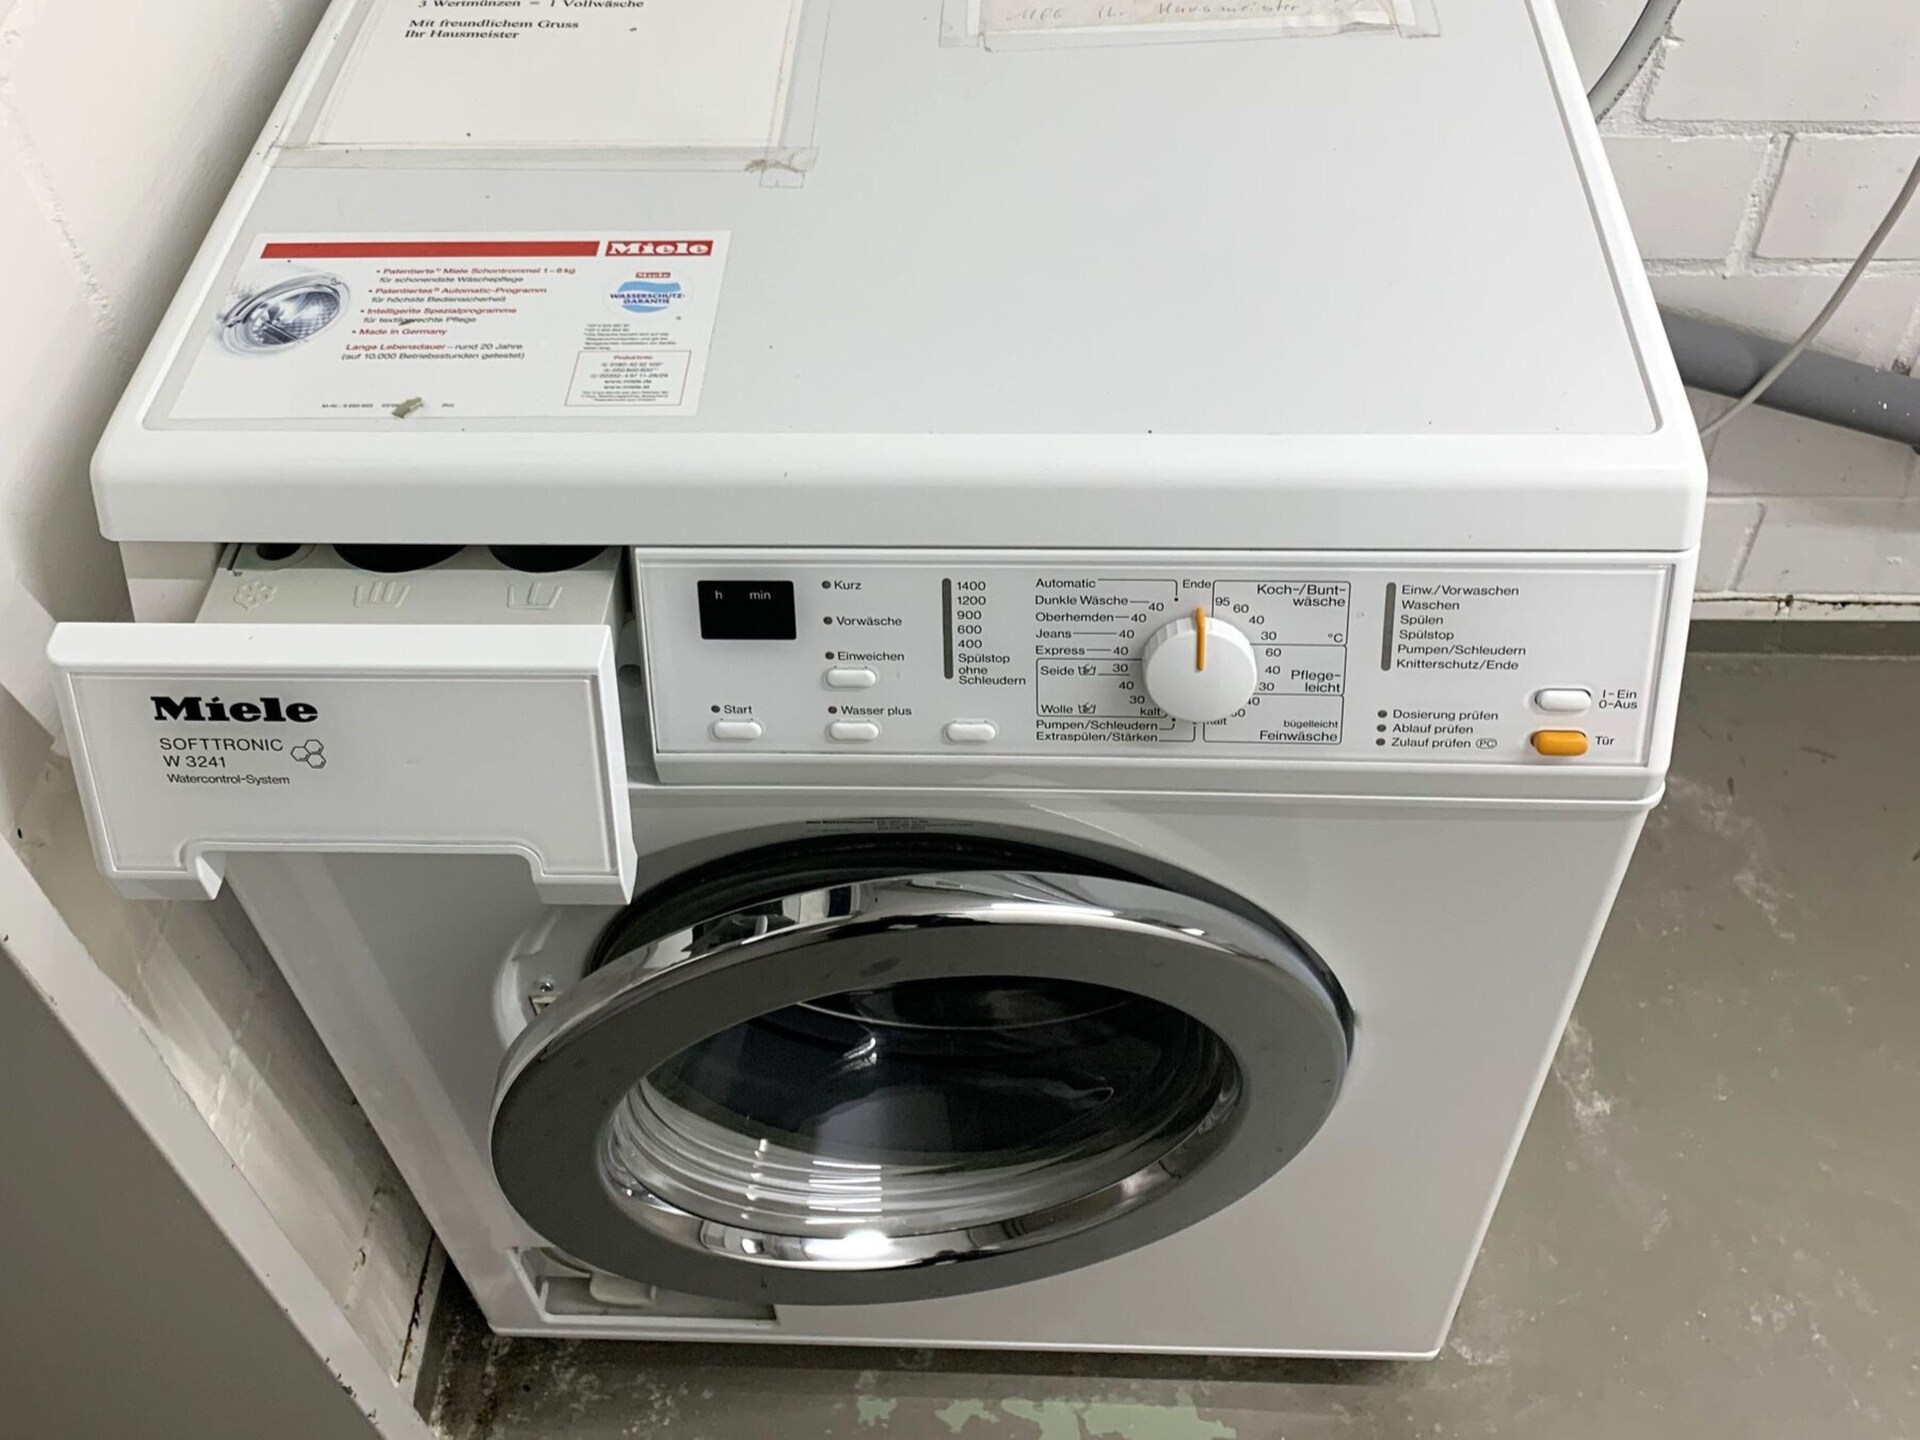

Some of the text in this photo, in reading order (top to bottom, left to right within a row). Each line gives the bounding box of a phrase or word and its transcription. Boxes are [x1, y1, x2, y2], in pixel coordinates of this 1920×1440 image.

[440, 19, 532, 28] freundlichem
[538, 20, 578, 28] Gruss
[405, 30, 519, 38] Ihr Hausmeister
[607, 242, 710, 256] Miele
[442, 267, 469, 275] Miele
[367, 307, 517, 317] Intelligente Spezialprogramme
[446, 316, 476, 324] Pflege
[402, 328, 447, 336] Germany
[481, 352, 525, 360] getestet)
[834, 580, 861, 590] Kurz
[957, 581, 986, 591] 1400
[1036, 578, 1095, 588] Automatic
[1183, 579, 1211, 588] Ende
[715, 590, 771, 599] h min
[1257, 584, 1345, 595] Koch-/Bunt-
[1402, 585, 1519, 595] Einw./Vorwaschen
[958, 596, 986, 605] 1200
[1035, 595, 1128, 605] Dunkle Wäsche
[1215, 597, 1230, 606] 95
[1293, 596, 1345, 607] wäsche
[1402, 600, 1459, 610] Waschen
[1148, 601, 1164, 612] 40
[1233, 604, 1249, 613] 60
[957, 610, 981, 620] 900
[1036, 612, 1114, 622] Oberhemden
[1131, 614, 1147, 623] 40
[1249, 615, 1264, 624] 40
[836, 616, 902, 626] Vorwäsche
[1400, 615, 1443, 626] Spülen
[957, 625, 982, 634] 600
[1036, 629, 1071, 638] Jeans
[1119, 630, 1134, 639] 40
[1261, 631, 1277, 640] 30
[1328, 633, 1343, 643] °C
[1399, 629, 1454, 641] Spülstop
[958, 639, 982, 648] 400
[1036, 645, 1085, 656] Express
[1113, 646, 1129, 655] 40
[1266, 648, 1281, 657] 60
[1398, 644, 1526, 655] Pumpen/Schleudern
[838, 651, 904, 661] Einweichen
[958, 653, 1010, 664] Spülstop
[1113, 663, 1129, 674] 30
[1397, 659, 1518, 670] Knitterschutz/Ende
[958, 666, 988, 676] ohne
[1041, 666, 1074, 675] Seide
[1265, 666, 1280, 675] 40
[959, 675, 1026, 685] Schleudern
[1291, 670, 1340, 683] Pflege-
[1119, 681, 1135, 690] 40
[1259, 682, 1274, 691] 30
[1305, 682, 1340, 693] leicht
[1129, 695, 1145, 704] 30
[150, 696, 318, 722] Miele
[724, 705, 752, 714] Start
[841, 706, 912, 717] Wasser plus
[1041, 704, 1073, 714] Wolle
[1140, 707, 1160, 717] kalt
[1393, 709, 1498, 721] Dosierung prüfen
[1036, 718, 1159, 731] Pumpen/Schleudern
[1284, 720, 1338, 729] bügelleicht
[1393, 723, 1473, 735] Ablauf prüfen
[1037, 730, 1159, 742] Extraspülen/Stärken
[1258, 730, 1337, 743] Feinwäsche
[1595, 736, 1614, 745] Tür
[160, 738, 283, 751] SOFTTRONIC
[1391, 737, 1429, 747] Zulauf
[1432, 738, 1471, 748] prüfen
[163, 755, 225, 768] W 3241
[167, 774, 290, 786] Watercontrol-System
